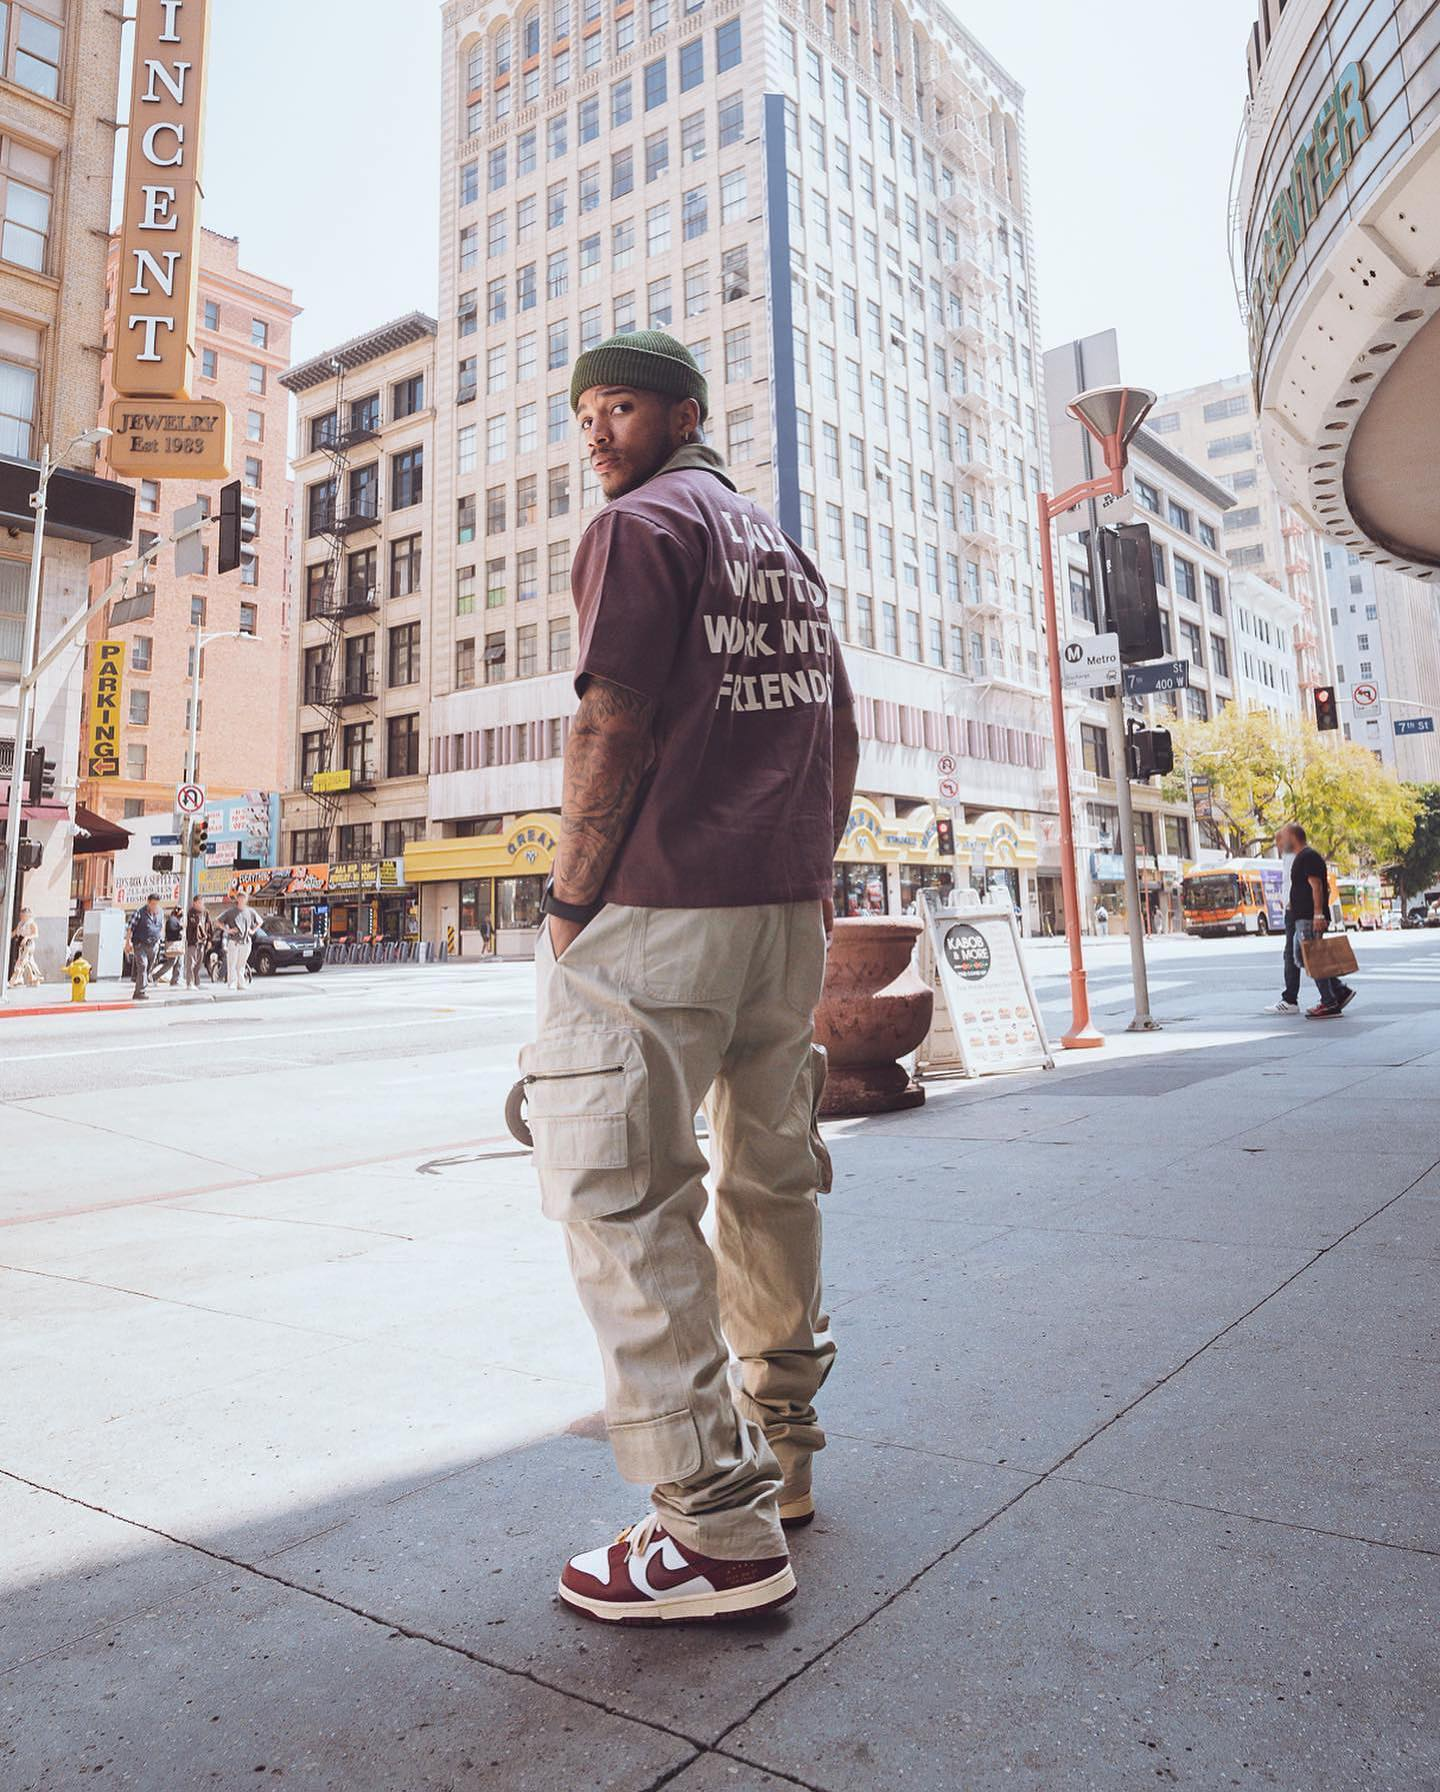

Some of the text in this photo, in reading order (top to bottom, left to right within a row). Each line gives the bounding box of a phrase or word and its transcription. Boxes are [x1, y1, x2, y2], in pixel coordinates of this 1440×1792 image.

[1262, 60, 1372, 306] CENTER
[117, 413, 219, 435] JEWELRY
[129, 437, 158, 454] Est
[719, 510, 744, 544] I
[1087, 655, 1116, 666] Metro
[1173, 663, 1183, 673] St
[1155, 676, 1185, 691] 400 W
[93, 645, 120, 758] PARKING
[1418, 721, 1429, 730] St
[947, 936, 984, 950] KABOB
[961, 948, 989, 960] MORE
